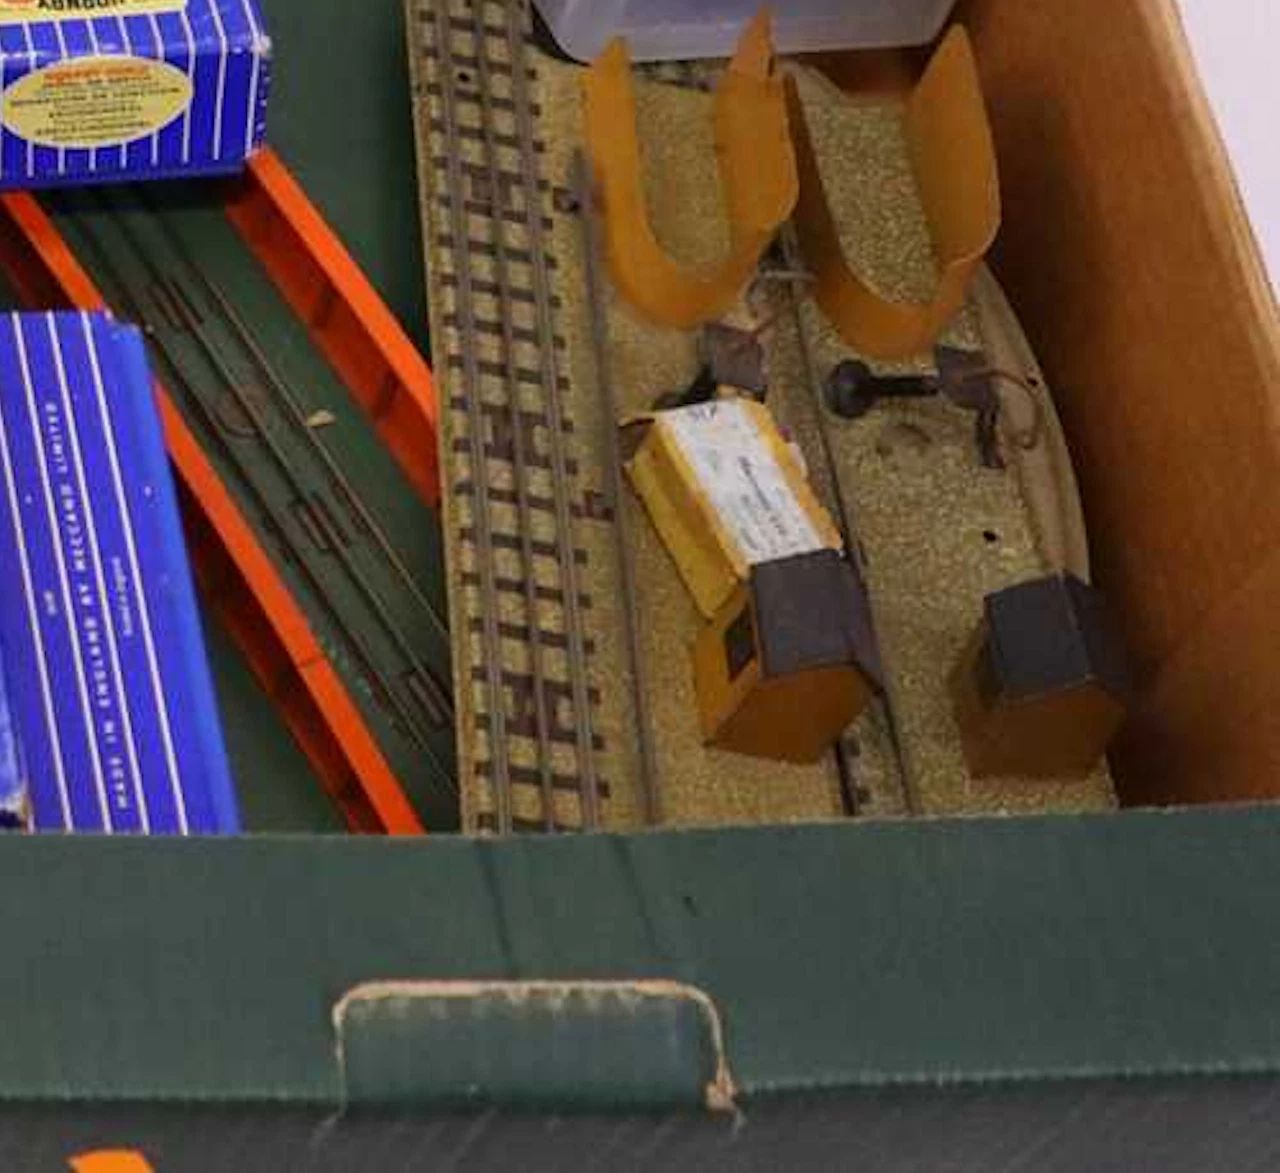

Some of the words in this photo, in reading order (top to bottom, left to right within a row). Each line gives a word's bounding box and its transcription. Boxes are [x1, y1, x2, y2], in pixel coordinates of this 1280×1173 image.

[45, 402, 69, 474] LIMITED
[58, 482, 87, 573] MECCANO
[78, 580, 94, 608] BY
[83, 616, 111, 709] ENGLAND
[103, 720, 117, 744] IN
[108, 755, 129, 810] MADE
